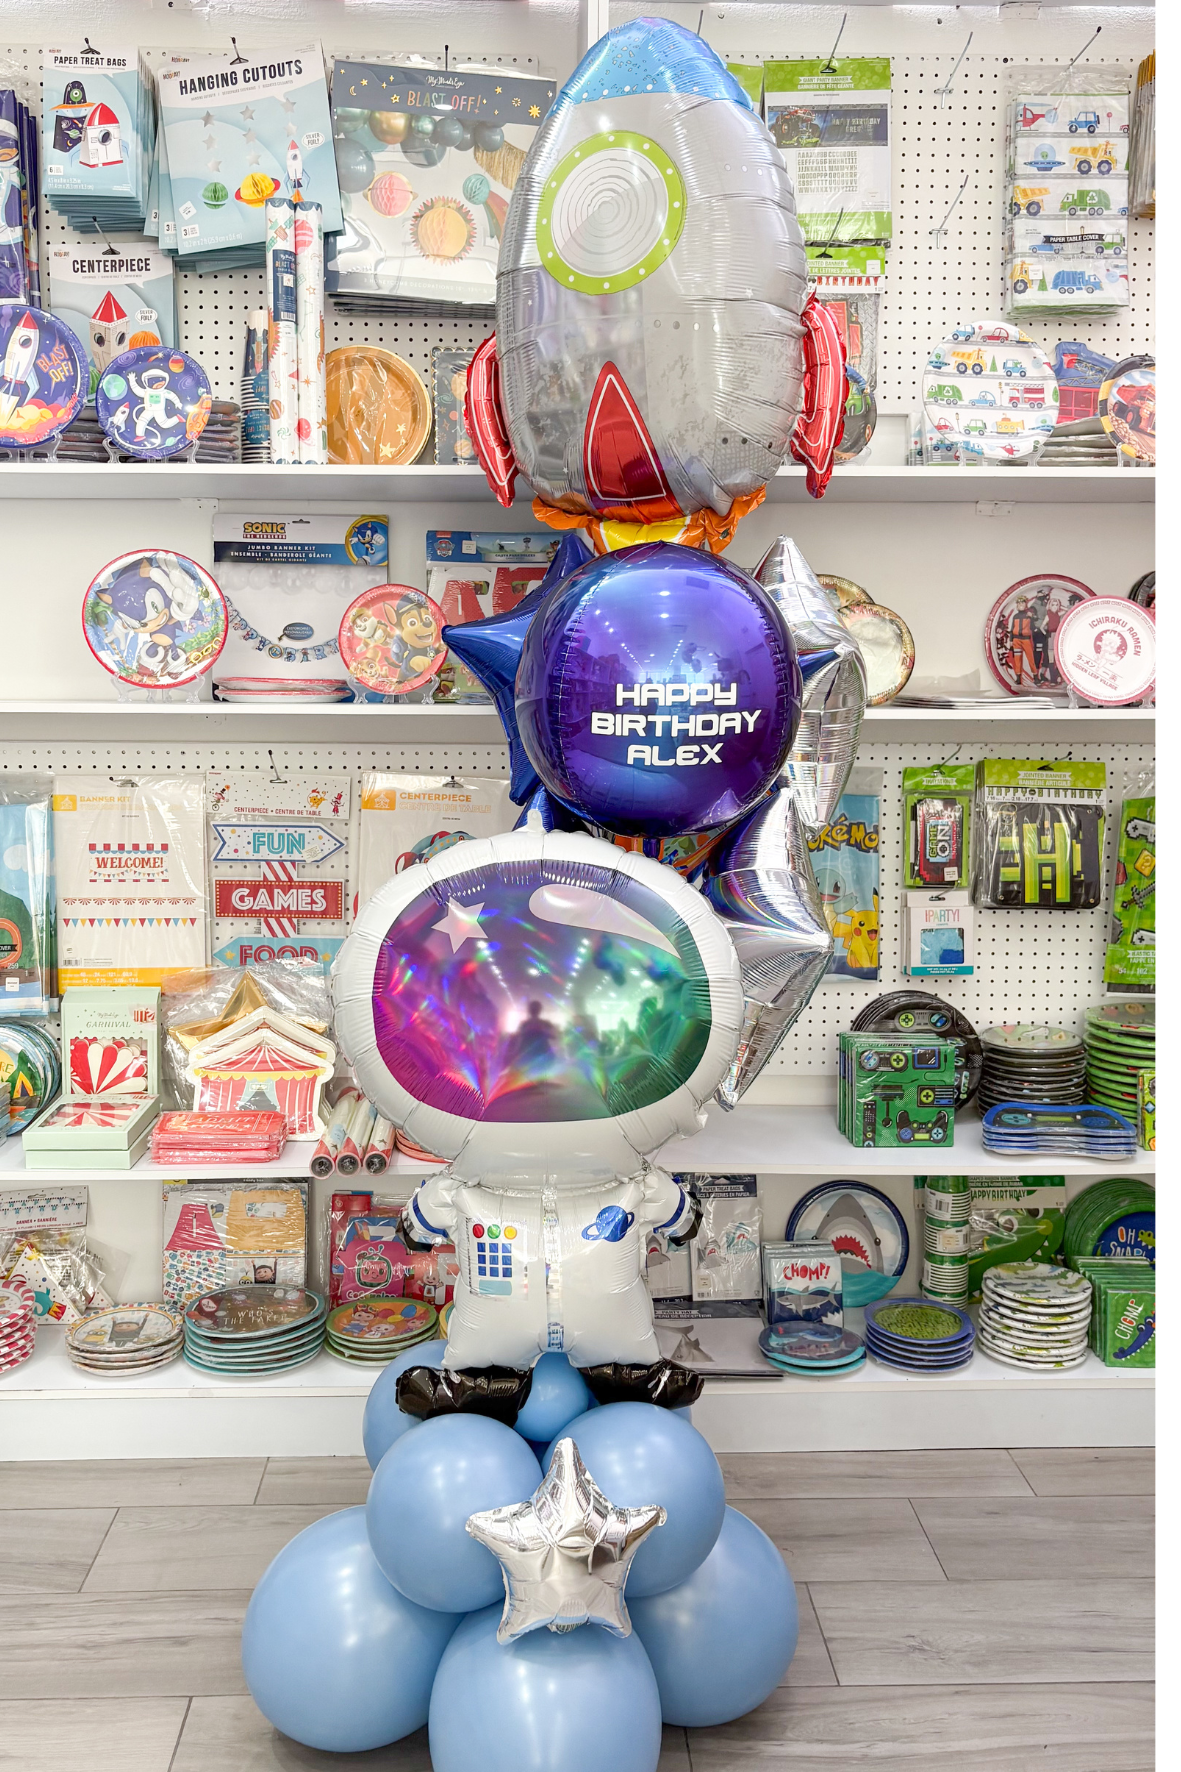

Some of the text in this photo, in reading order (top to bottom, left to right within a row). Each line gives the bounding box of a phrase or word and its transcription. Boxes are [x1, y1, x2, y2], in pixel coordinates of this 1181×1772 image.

[54, 56, 127, 67] PAPER TREAT BAGS
[179, 71, 238, 95] HANGING
[242, 59, 303, 83] CUTOUTS
[407, 90, 482, 114] BLAST OFF!
[153, 211, 158, 219] 3
[165, 224, 170, 232] 3
[183, 228, 188, 237] 3
[72, 258, 151, 273] CENTERPIECE
[817, 276, 879, 286] BIRTHDAY
[36, 344, 69, 373] BLAST
[48, 361, 74, 382] OFF!
[243, 522, 286, 534] SONIC
[1088, 616, 1142, 657] ICHIRAKU RAMEN
[1071, 661, 1088, 673] HIDDEN
[1088, 670, 1100, 680] LEAF
[616, 682, 737, 706] HAPPY
[591, 709, 762, 737] BIRTHDAY
[626, 742, 724, 767] ALEX
[400, 792, 472, 803] CENTERPIECE
[988, 787, 1102, 799] HAPPY BIRTHDAY
[399, 802, 492, 814] CENTRE DE TABLE
[252, 832, 305, 855] FUN
[929, 825, 950, 857] GAME ON
[95, 857, 164, 869] WELCOME!
[1022, 822, 1071, 903] H
[231, 887, 327, 911] GAMES
[239, 944, 319, 966] FOOD
[991, 1190, 1027, 1201] BIRTHDAY
[1118, 1226, 1136, 1245] OH
[783, 1262, 831, 1281] CHOMP!
[224, 1317, 243, 1325] THE
